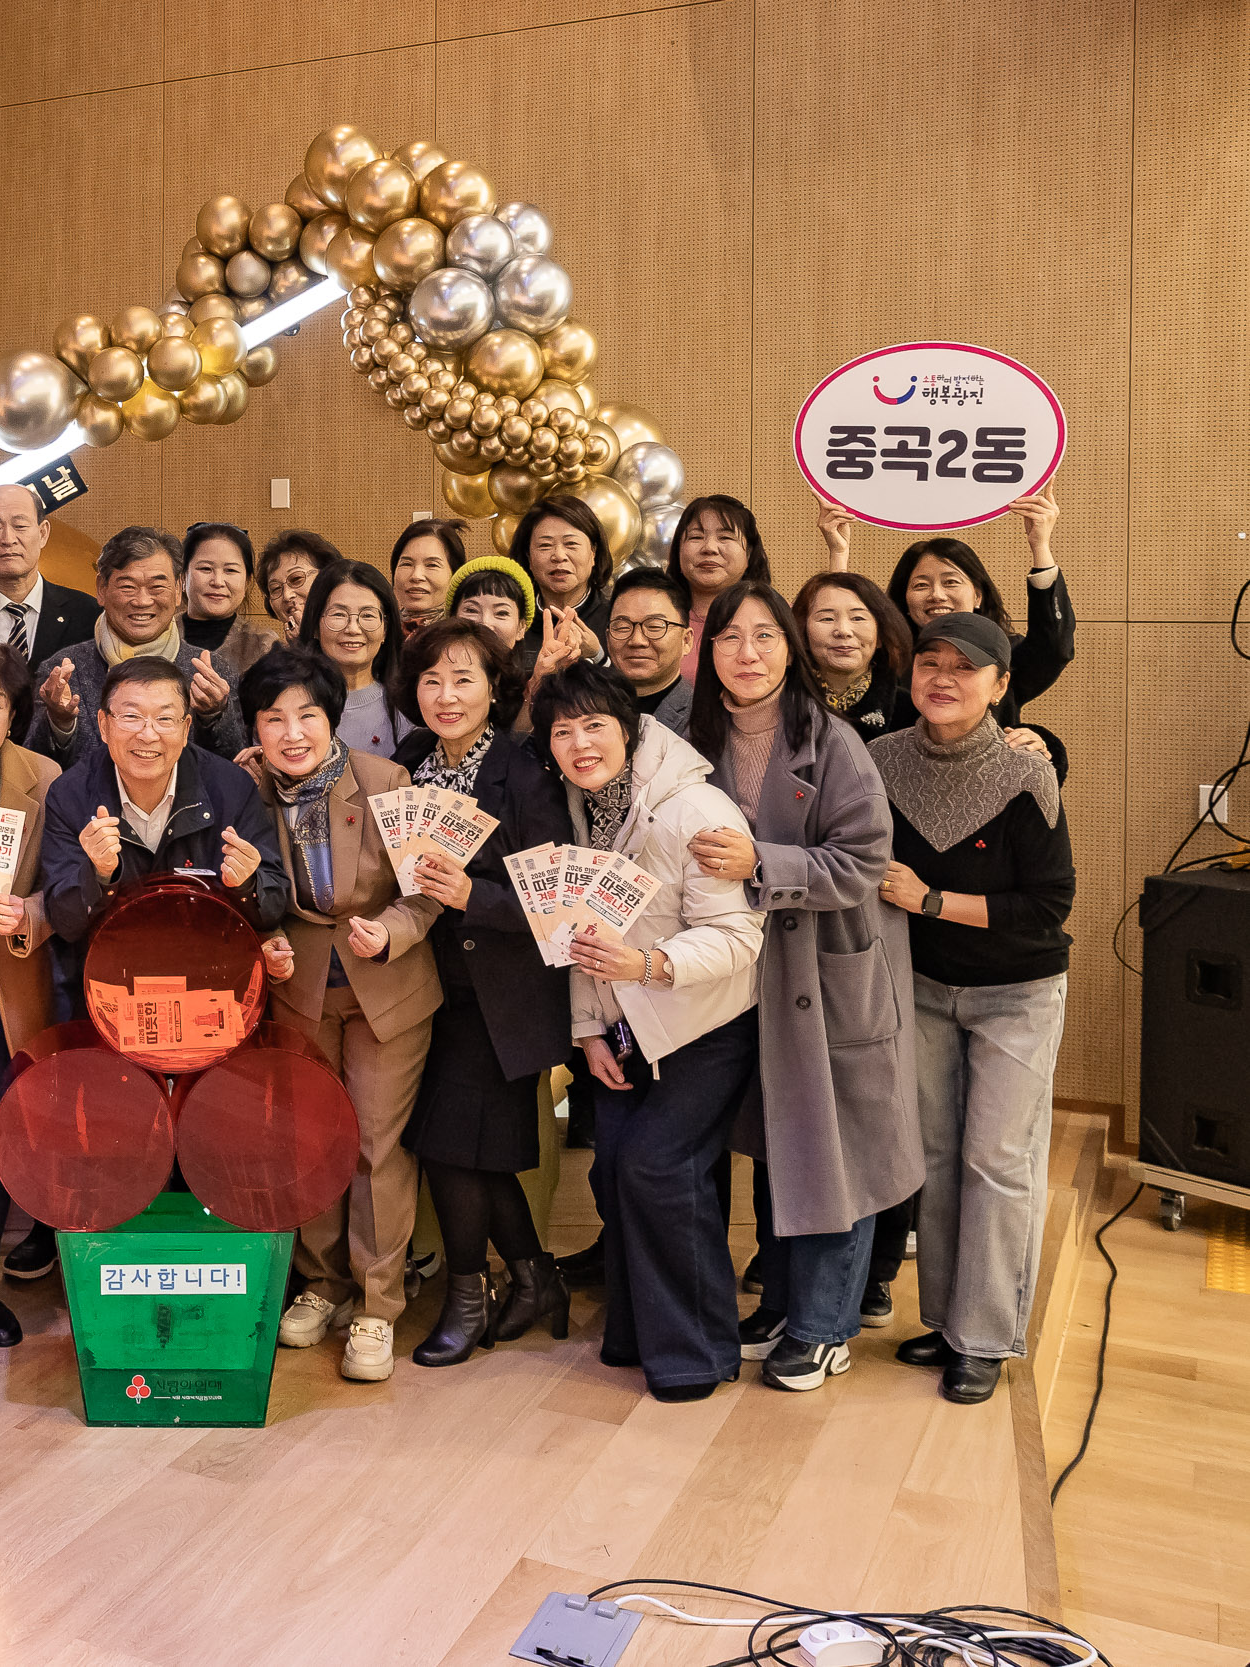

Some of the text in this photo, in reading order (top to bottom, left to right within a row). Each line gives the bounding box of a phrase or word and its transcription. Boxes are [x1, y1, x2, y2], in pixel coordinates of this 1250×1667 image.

[922, 374, 985, 387] 소통하여 발전하는
[921, 385, 984, 407] 행복광진
[825, 425, 1027, 484] 중곡2동
[41, 465, 79, 502] 날
[425, 801, 441, 811] 2026
[436, 823, 474, 849] 겨울나기
[440, 814, 480, 842] 따뜻한
[530, 871, 546, 880] 2026
[564, 871, 593, 887] 따뜻
[566, 864, 583, 873] 2026
[532, 875, 559, 893] 따뜻
[563, 884, 585, 896] 겨울
[598, 875, 641, 909] 따뜻한
[536, 889, 557, 902] 겨울
[593, 885, 633, 917] 겨울나기
[144, 1001, 159, 1045] 따뜻한
[104, 1267, 241, 1291] 감사합니다!
